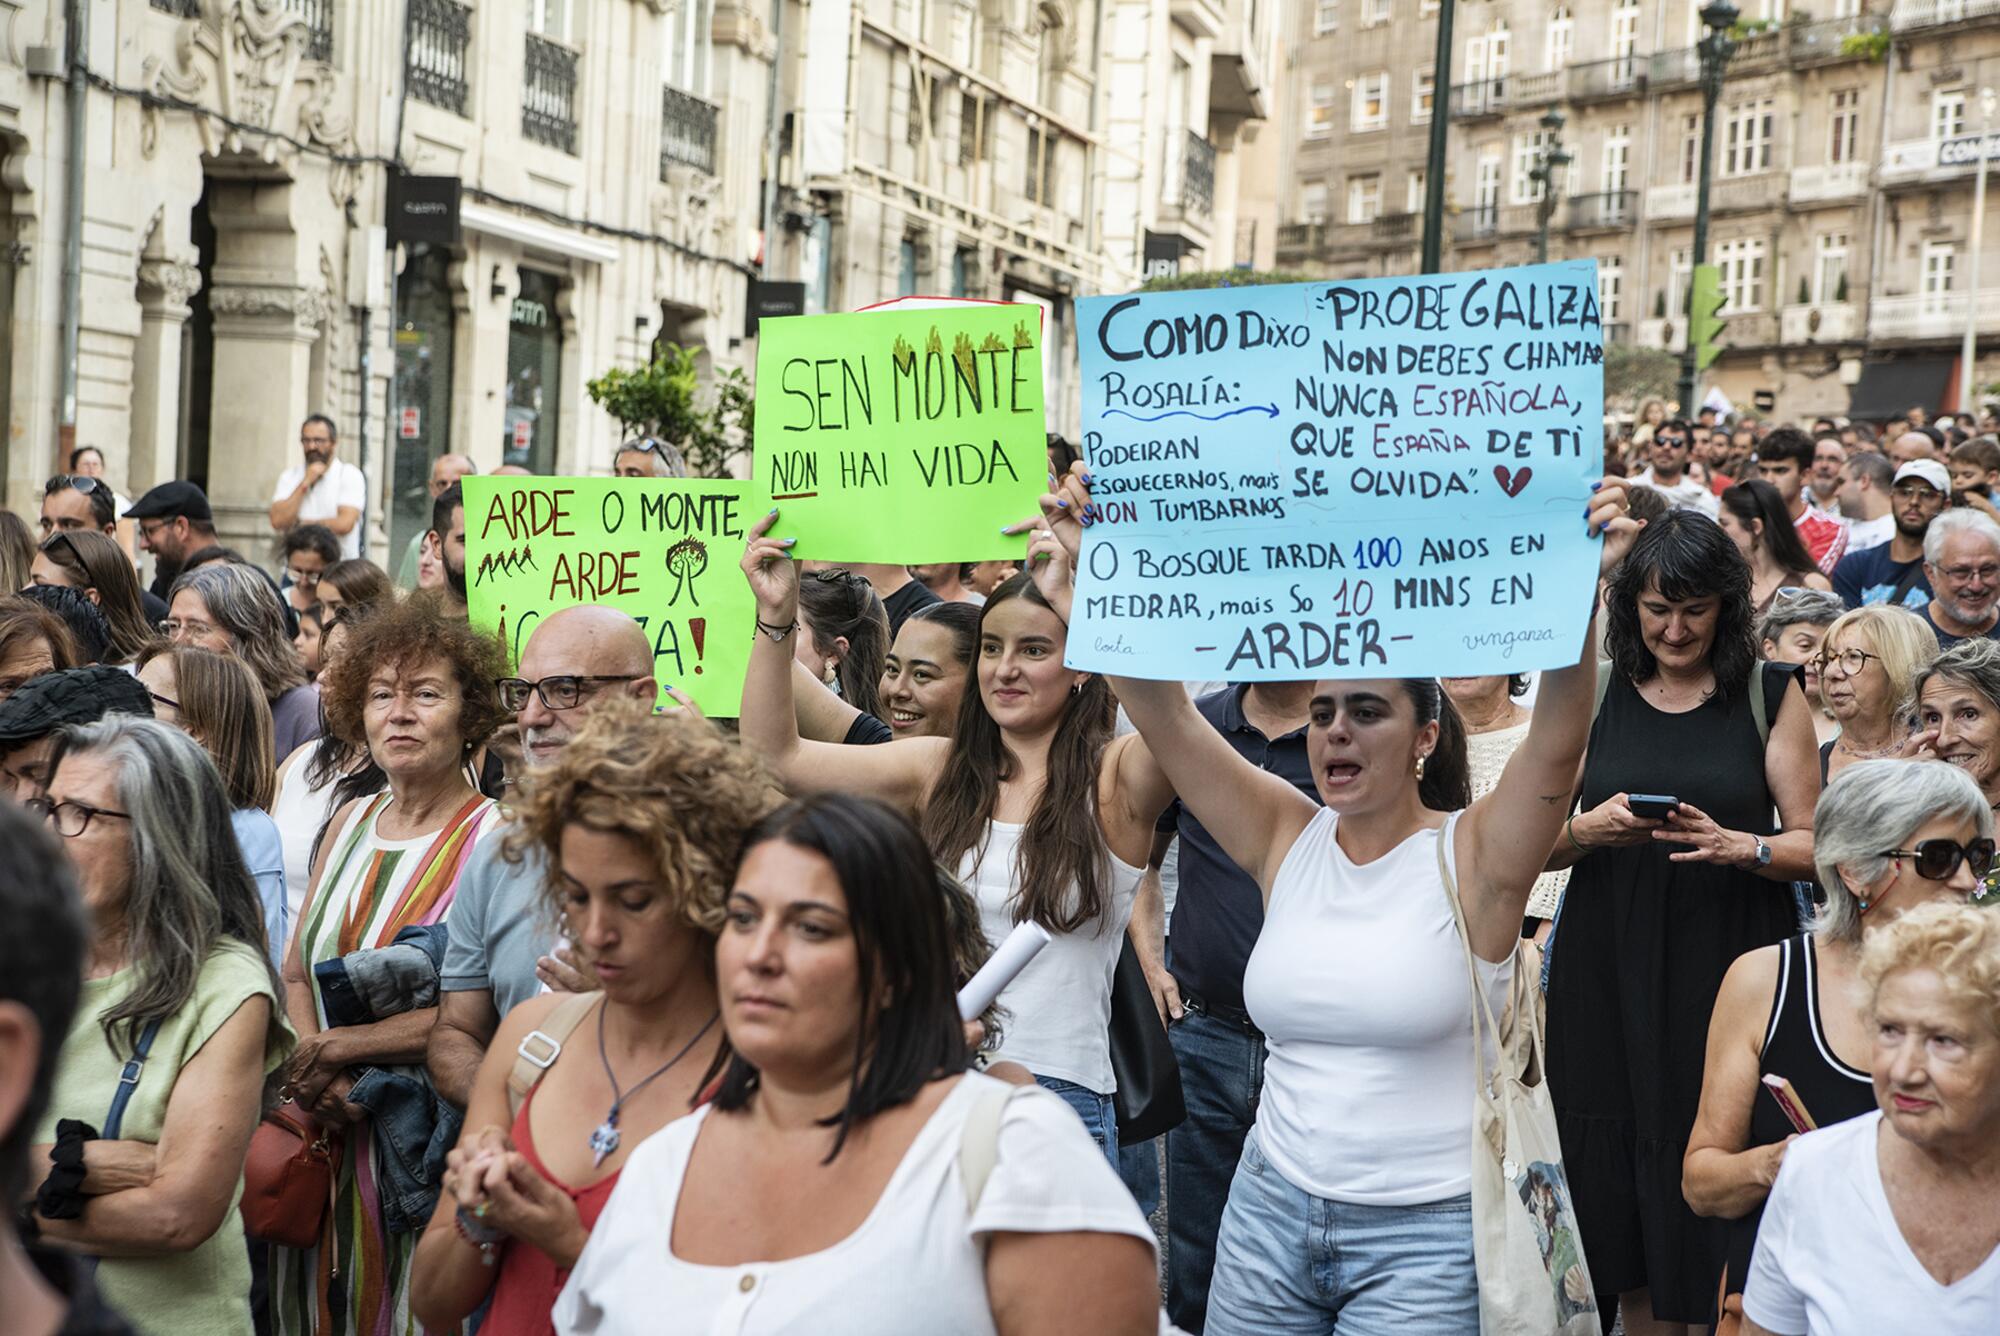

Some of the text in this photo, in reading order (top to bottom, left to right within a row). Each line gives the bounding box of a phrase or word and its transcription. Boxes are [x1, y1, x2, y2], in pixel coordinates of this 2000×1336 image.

[1460, 277, 1600, 331] GALIZA
[1097, 298, 1228, 362] COMO
[1323, 340, 1387, 375] NON
[1397, 344, 1493, 376] DEBES
[782, 344, 1034, 432] SEN MONTE
[1100, 372, 1241, 409] ROSALÍA:
[1296, 376, 1582, 418] NUNCA ESPAÑOLA,
[1084, 431, 1200, 468] PODEIRAN
[1290, 422, 1354, 458] QUE
[1373, 423, 1471, 458] ESPAÑA
[1487, 429, 1532, 458] DE
[771, 440, 1019, 494] NON HAI VIDA
[1088, 470, 1280, 496] ESQUECERNOS, mais
[1292, 467, 1329, 497] SE
[481, 490, 744, 540] ARDE O MONTE,
[1090, 497, 1288, 527] NON TUMBARNOS
[550, 551, 641, 601] ARDE
[1089, 533, 1545, 581] O BOSQUE TARDA 100 ANOS EN
[1086, 593, 1214, 620] MEDRAR,
[1220, 596, 1274, 615] mais
[1333, 577, 1373, 617] 10
[1394, 575, 1471, 609] MINS
[1491, 572, 1533, 605] EN
